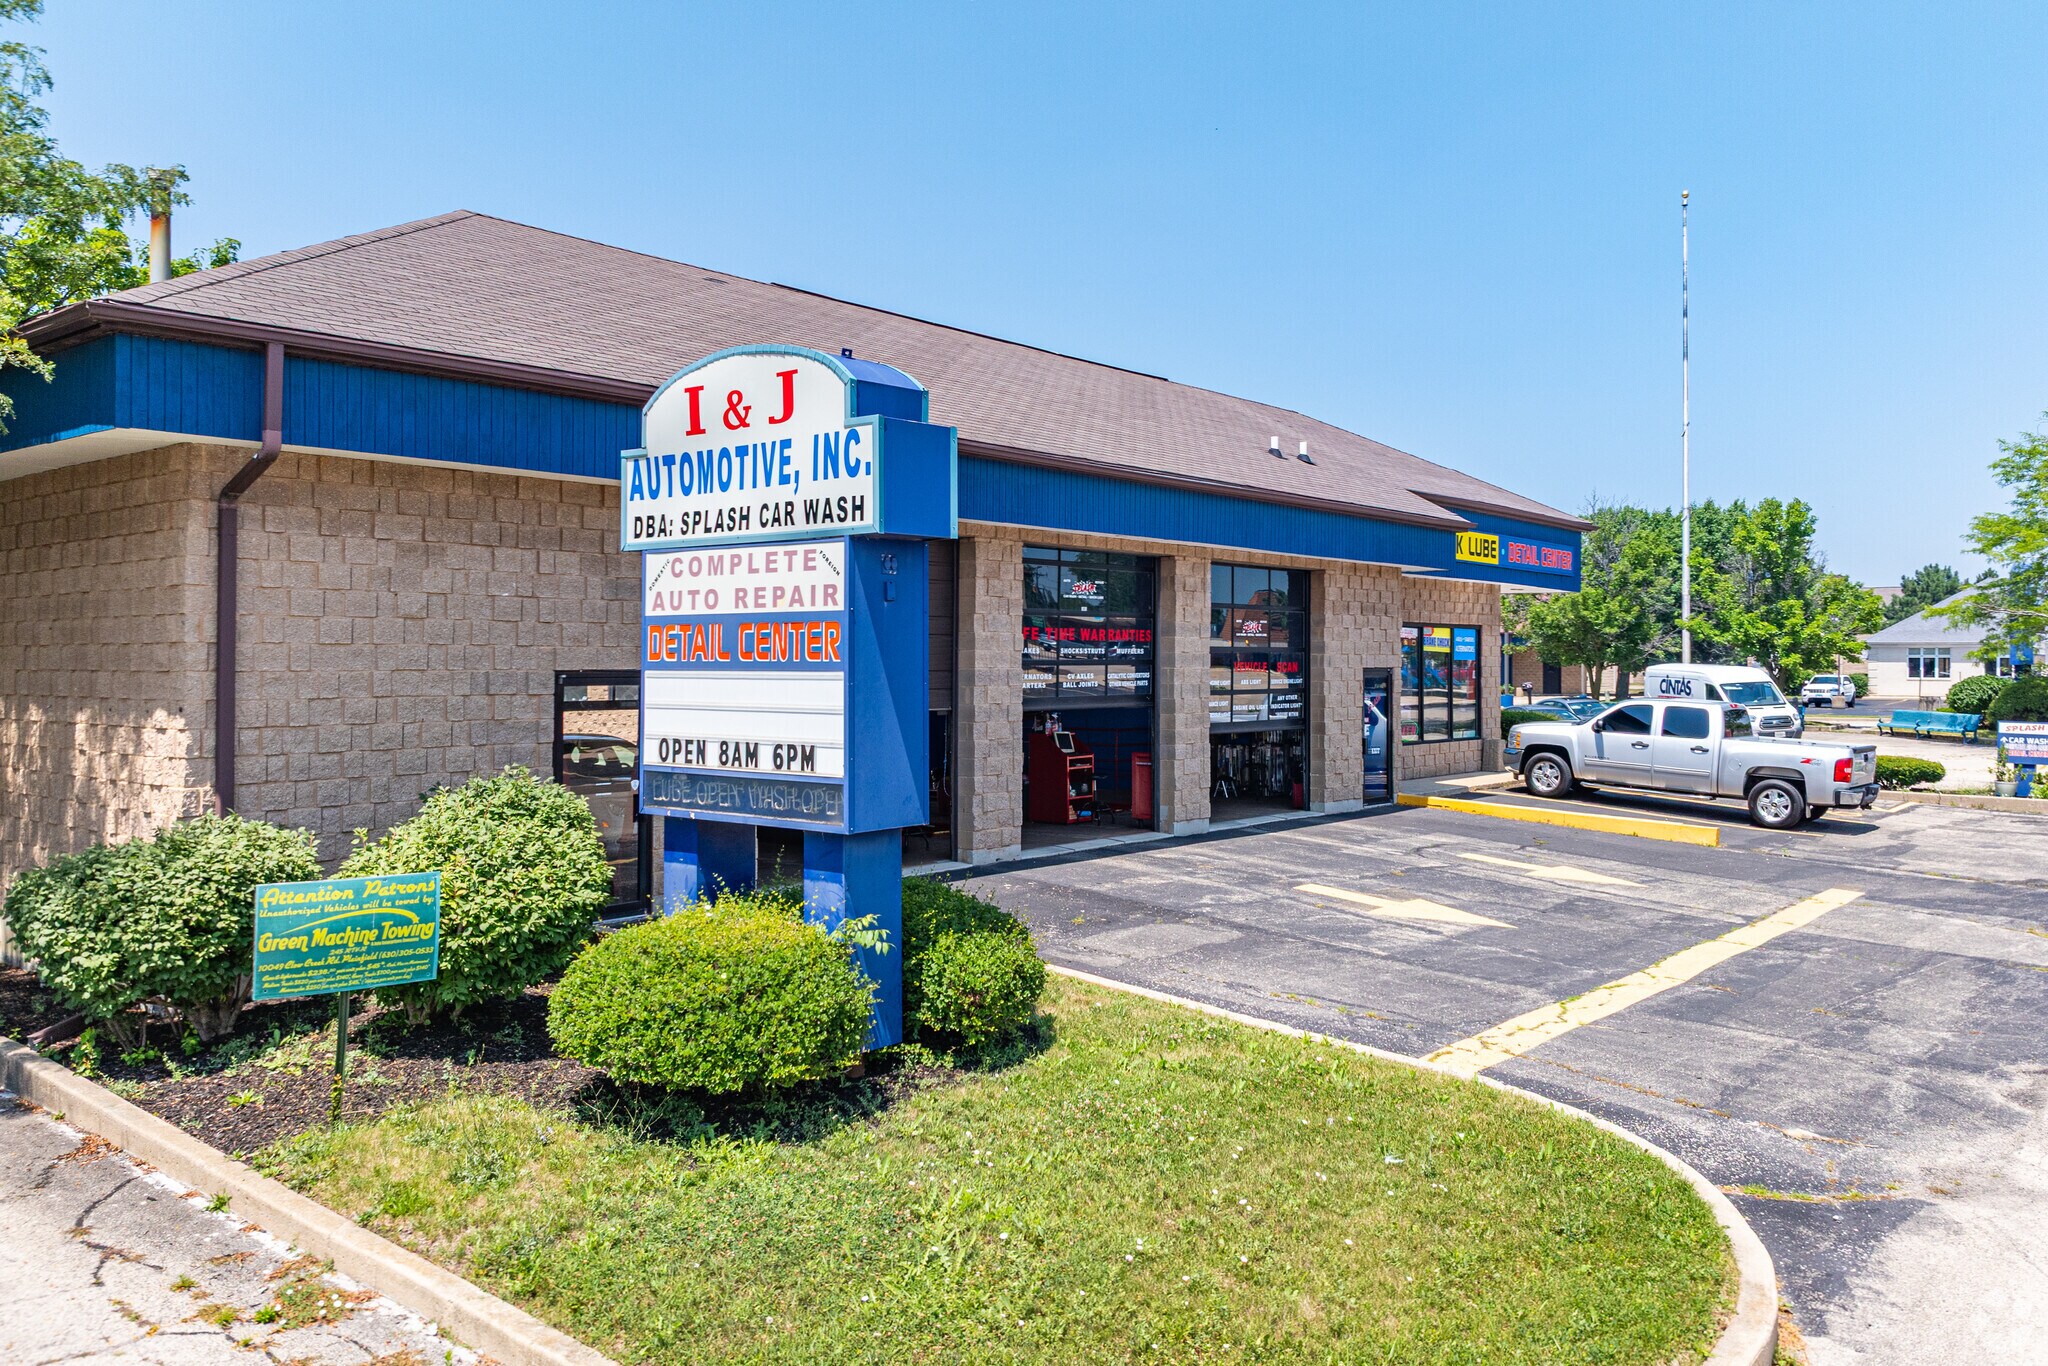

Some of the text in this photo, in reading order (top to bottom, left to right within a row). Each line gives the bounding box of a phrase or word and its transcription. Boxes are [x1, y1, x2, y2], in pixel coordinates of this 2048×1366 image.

[684, 369, 798, 436] I & J
[629, 428, 871, 502] AUTOMOTIVE, INC.
[634, 495, 865, 539] DBA: SPLASH CAR WASH
[670, 548, 817, 578] COMPLETE
[819, 550, 841, 577] FOREIGN
[1468, 536, 1496, 559] LUBE
[1508, 541, 1540, 566] DETAIL
[1541, 547, 1573, 571] CENTER
[649, 558, 671, 592] DOMESTIC
[651, 583, 839, 612] AUTO REPAIR
[647, 621, 841, 662] DETAIL CENTER
[1022, 627, 1151, 642] FE TIME WARRANTIES
[1234, 661, 1298, 673] VEHICLE SCAN
[1660, 674, 1692, 696] CINTAS
[659, 737, 816, 772] OPEN 8AM 6PM
[2008, 736, 2048, 745] CAR WASH
[259, 905, 321, 918] Unauthorized
[324, 903, 359, 913] Vehicles
[362, 900, 379, 909] will
[382, 899, 392, 907] be
[395, 897, 420, 906] towed
[260, 879, 436, 908] Attention Patrons
[258, 931, 309, 953] Green
[311, 926, 378, 948] Machine
[381, 920, 436, 941] Towing
